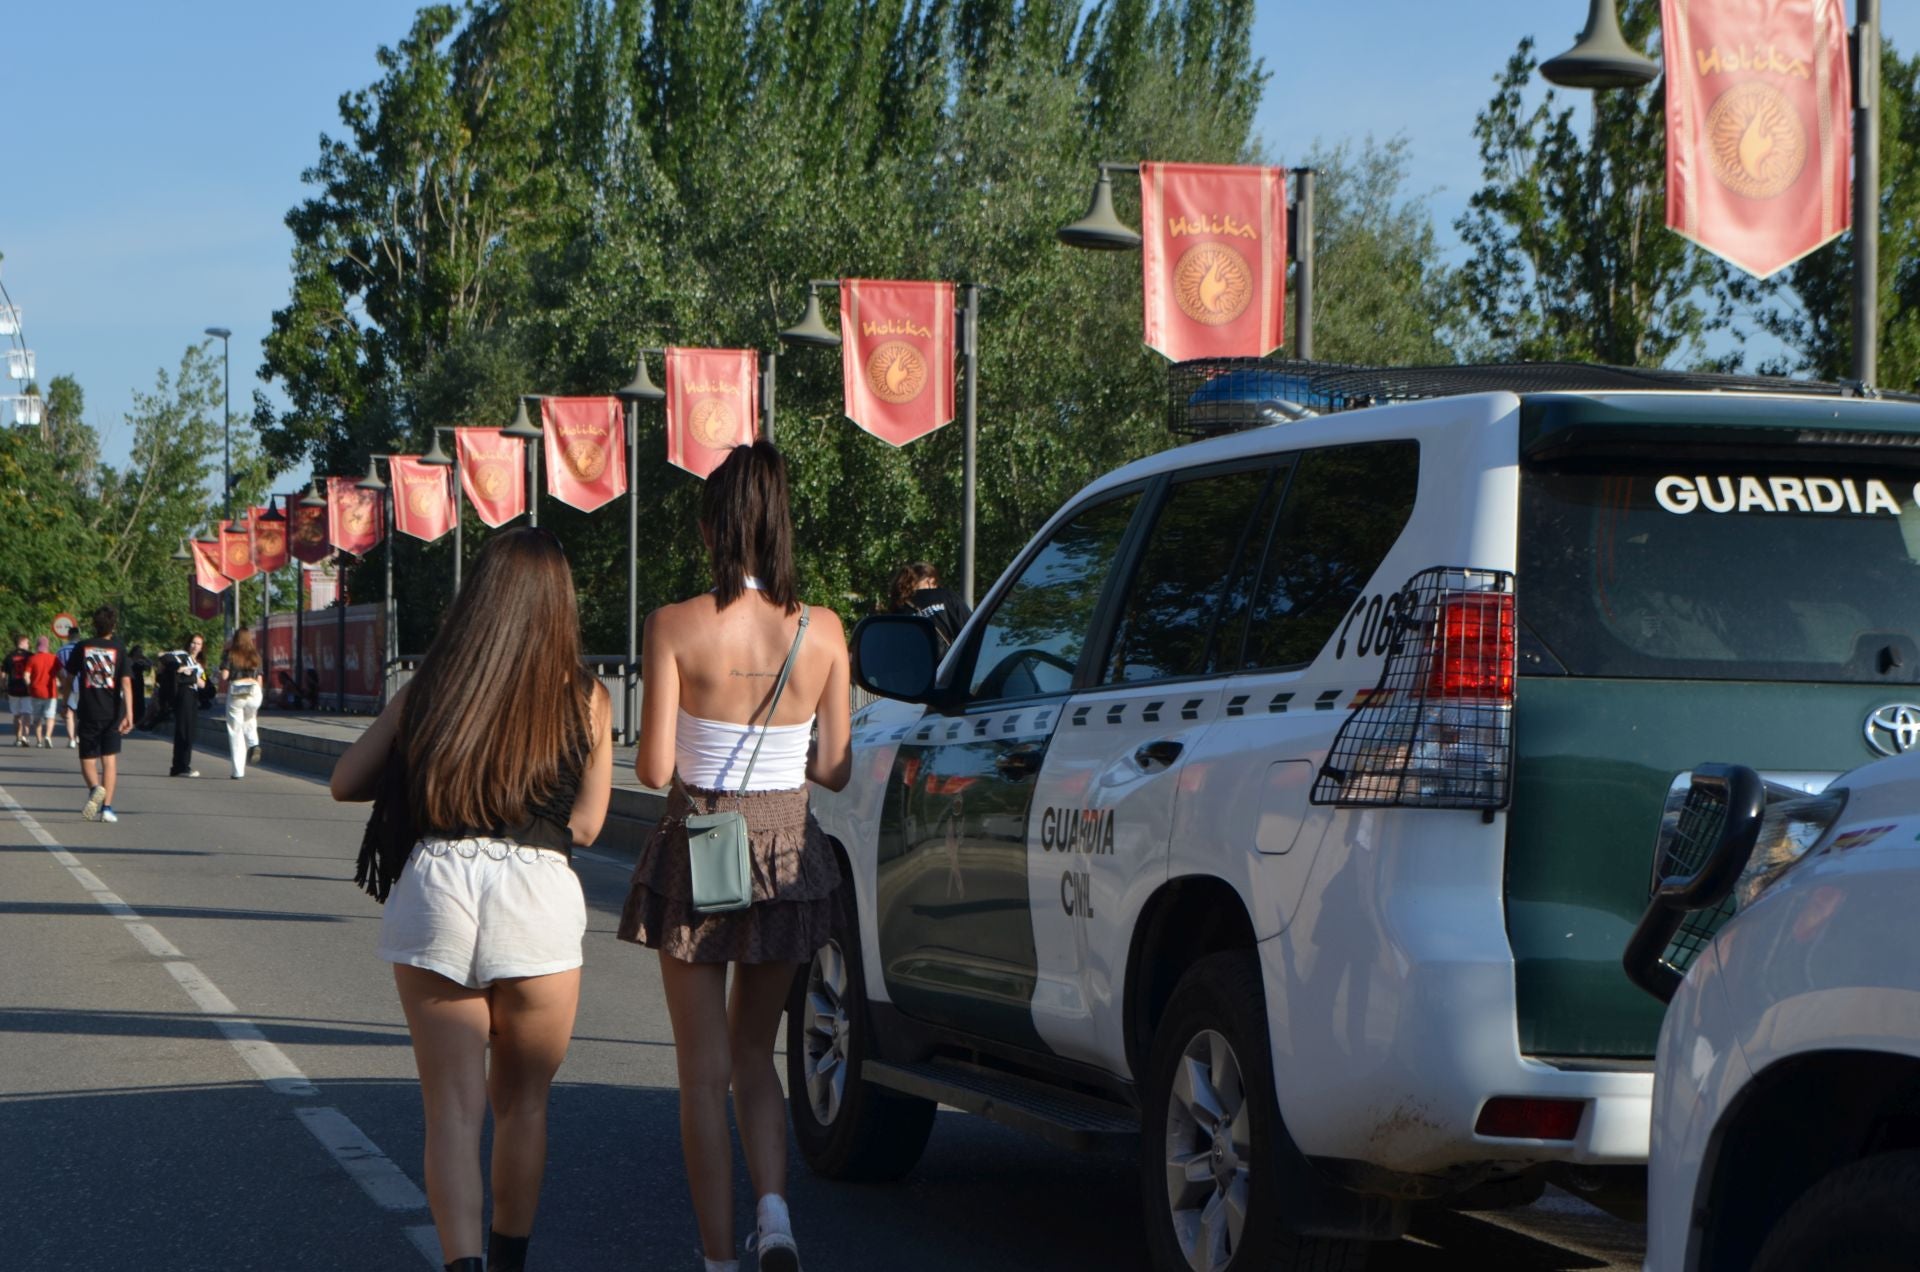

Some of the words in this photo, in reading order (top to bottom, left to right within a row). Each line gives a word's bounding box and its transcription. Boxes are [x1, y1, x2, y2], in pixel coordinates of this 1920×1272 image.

[1655, 476, 1902, 515] GUARDIA
[1041, 806, 1115, 855] GUARDIA
[1060, 870, 1094, 919] CIVIL
